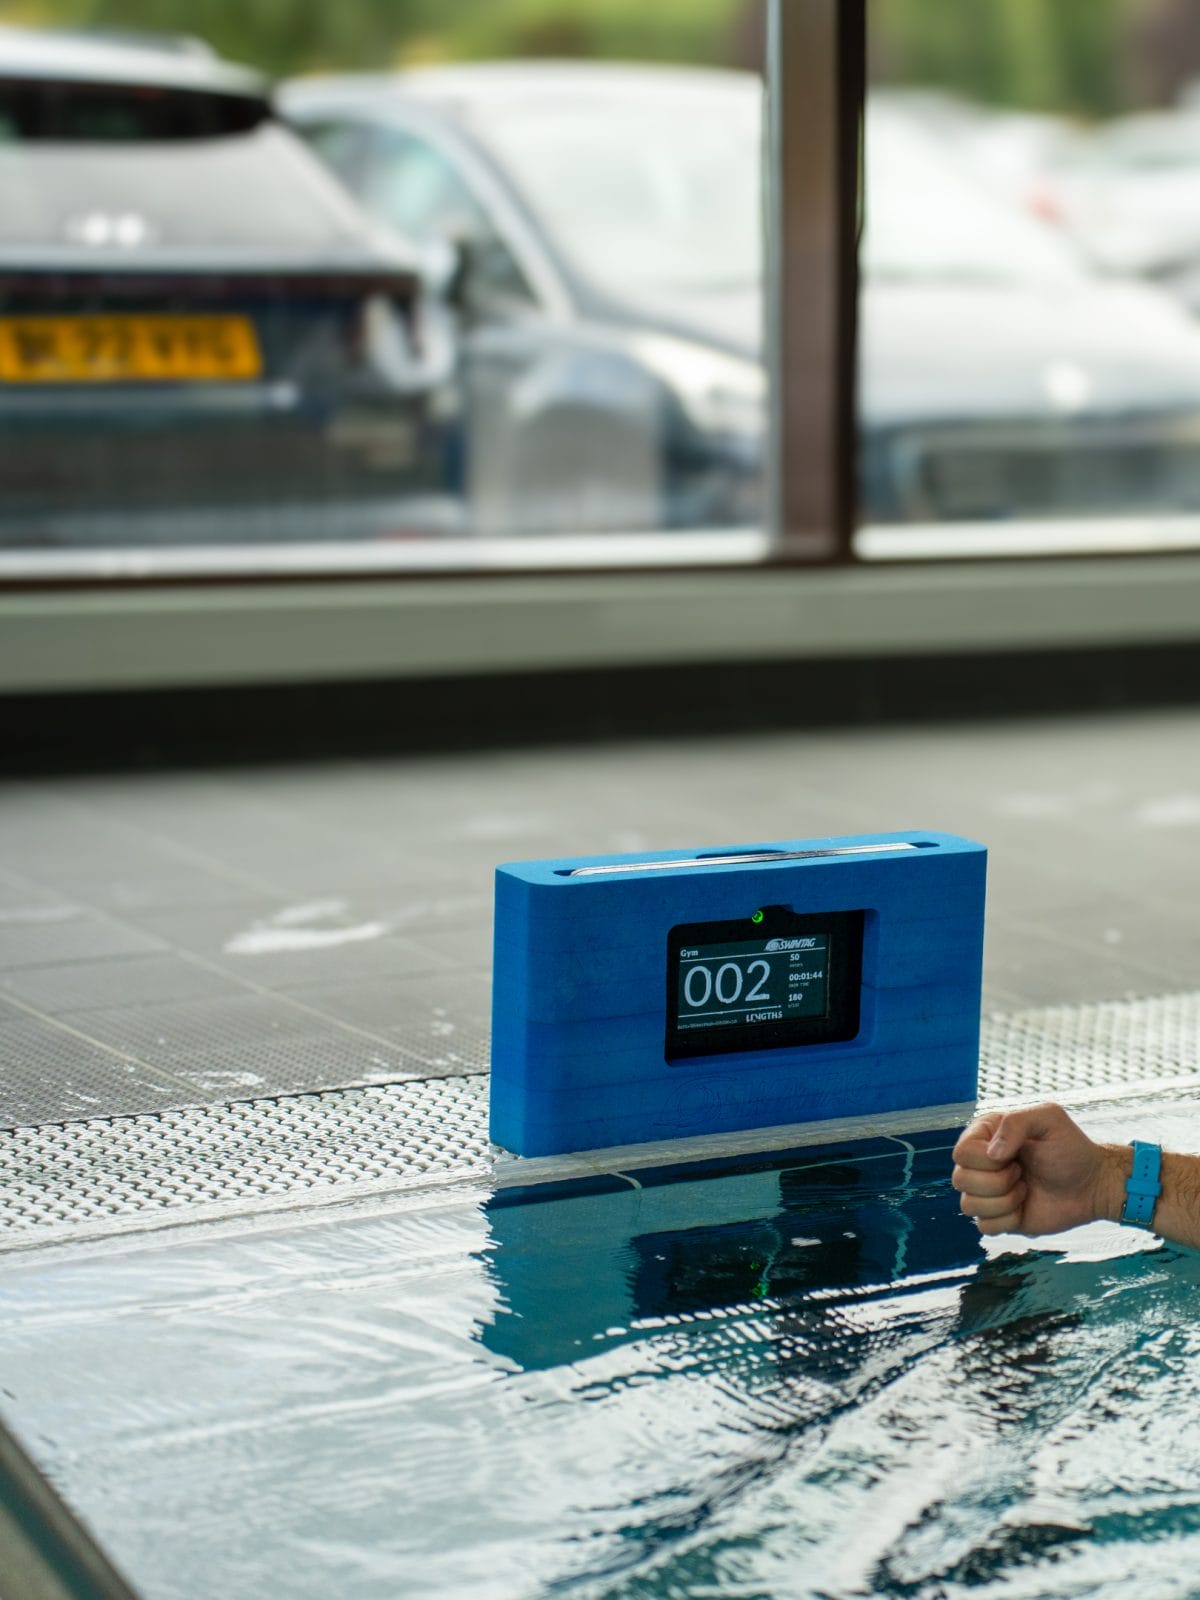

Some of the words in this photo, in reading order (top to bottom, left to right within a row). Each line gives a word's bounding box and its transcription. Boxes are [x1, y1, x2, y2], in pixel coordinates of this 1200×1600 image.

[680, 949, 699, 958] Gym
[790, 953, 800, 962] 50
[789, 971, 823, 981] 00:01:44
[684, 960, 771, 1008] 002
[746, 1011, 783, 1022] LENGTHS
